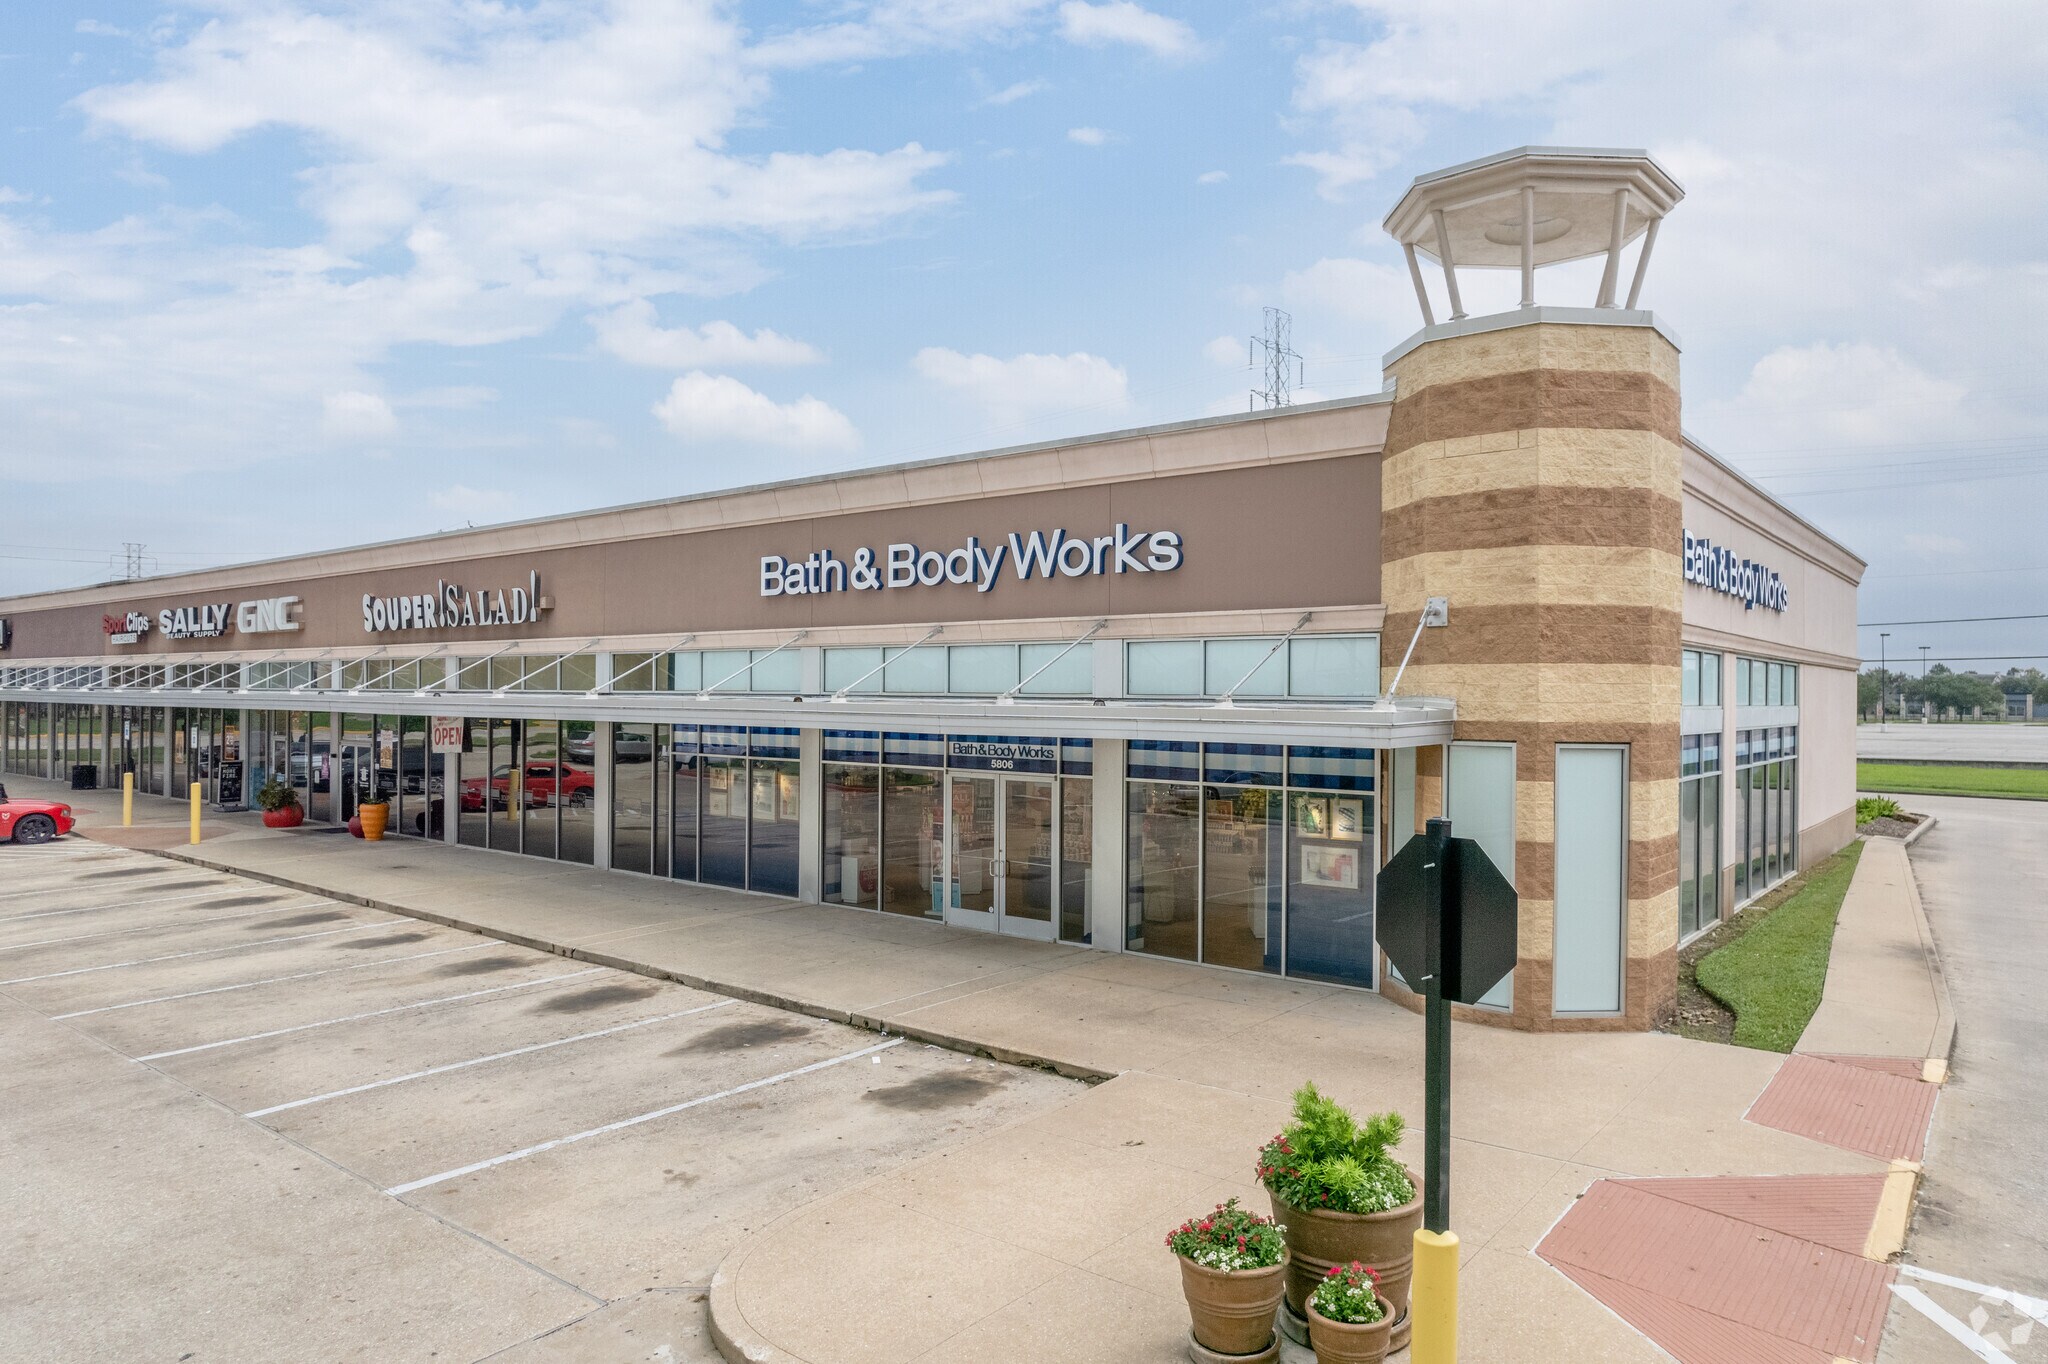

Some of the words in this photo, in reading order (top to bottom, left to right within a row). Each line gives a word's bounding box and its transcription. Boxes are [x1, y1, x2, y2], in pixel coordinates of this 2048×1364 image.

[1682, 528, 1717, 589] Bath
[1718, 546, 1730, 592] &
[760, 549, 848, 597] Bath
[850, 547, 884, 591] &
[159, 603, 231, 634] SALLY
[237, 595, 302, 634] GNC
[112, 634, 136, 643] HAIRCUTS
[166, 632, 190, 640] BEAUTY
[193, 630, 220, 638] SUPPLY
[434, 727, 462, 746] OPEN
[952, 742, 978, 755] Bath
[979, 744, 987, 756] &
[988, 744, 1017, 760] Body
[1018, 745, 1054, 759] Works
[991, 759, 1014, 770] 5806
